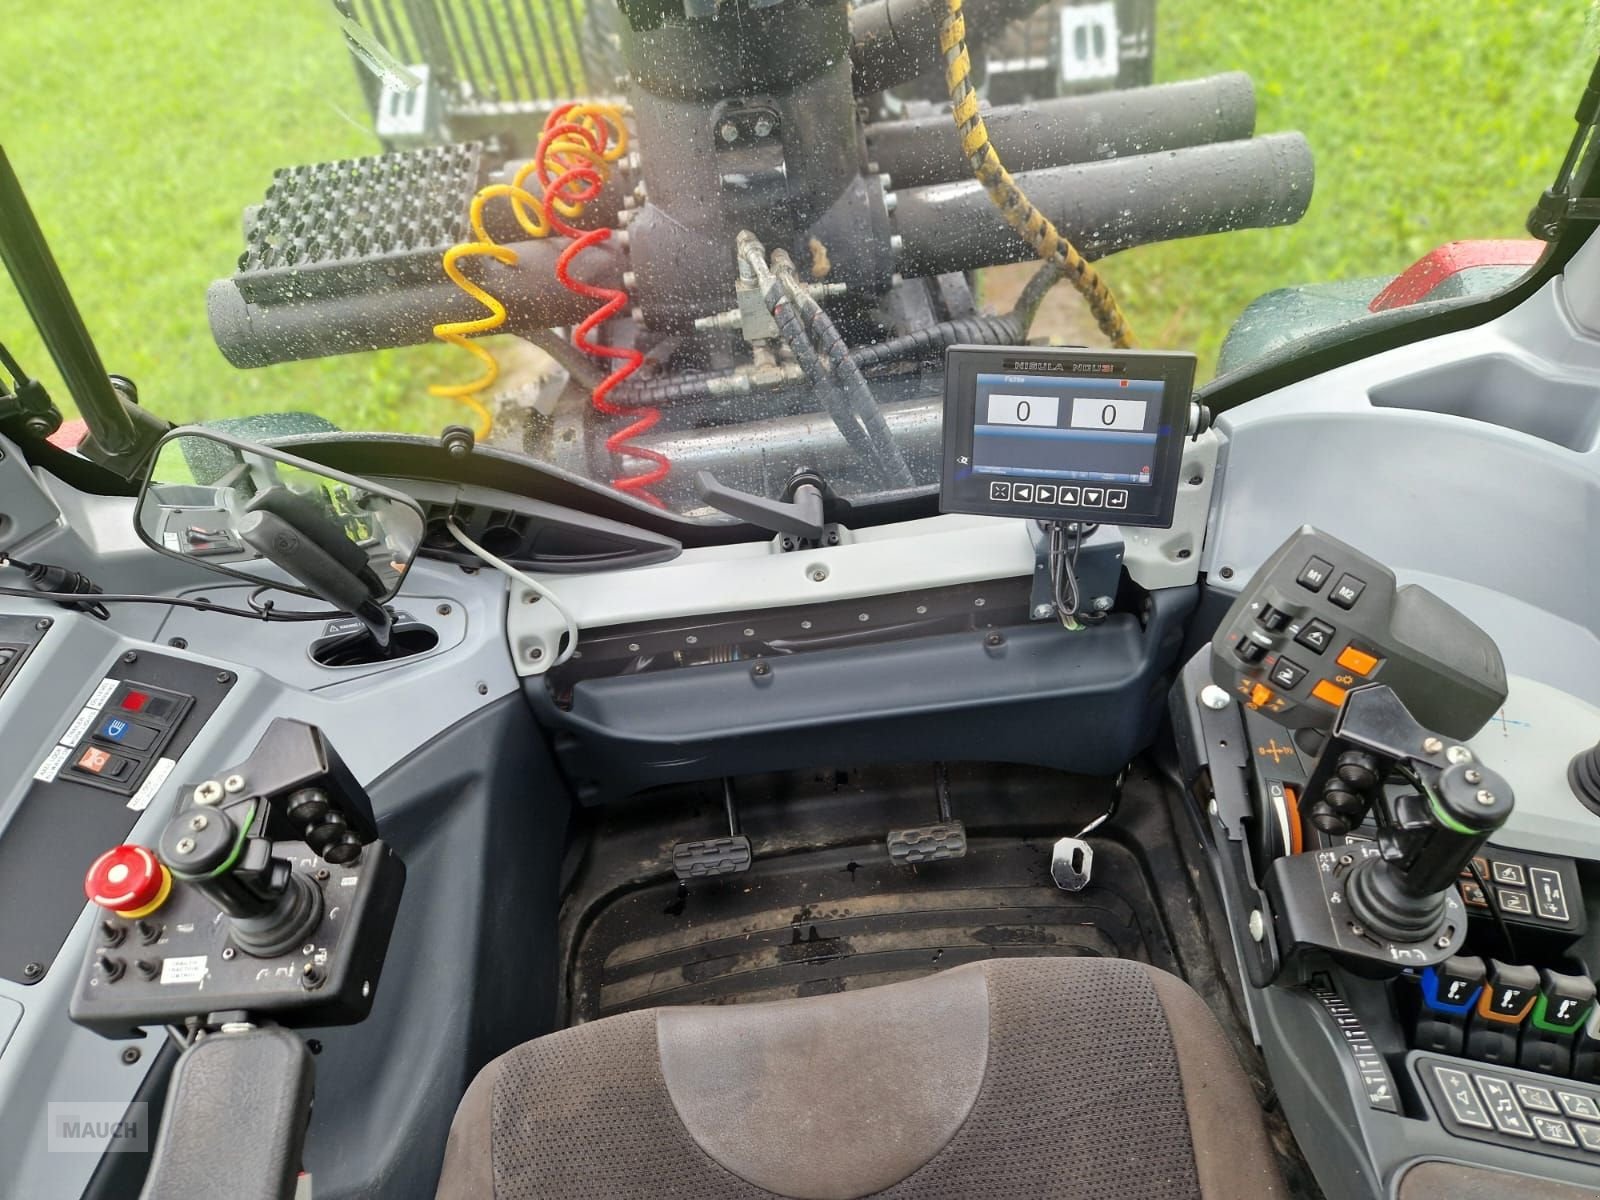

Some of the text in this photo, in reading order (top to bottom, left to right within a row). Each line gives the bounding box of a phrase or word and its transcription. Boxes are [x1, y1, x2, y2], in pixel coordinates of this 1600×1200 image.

[1014, 361, 1064, 372] NISULA
[1017, 401, 1116, 425] 0 0
[1307, 569, 1322, 582] M1
[1338, 586, 1355, 600] M2
